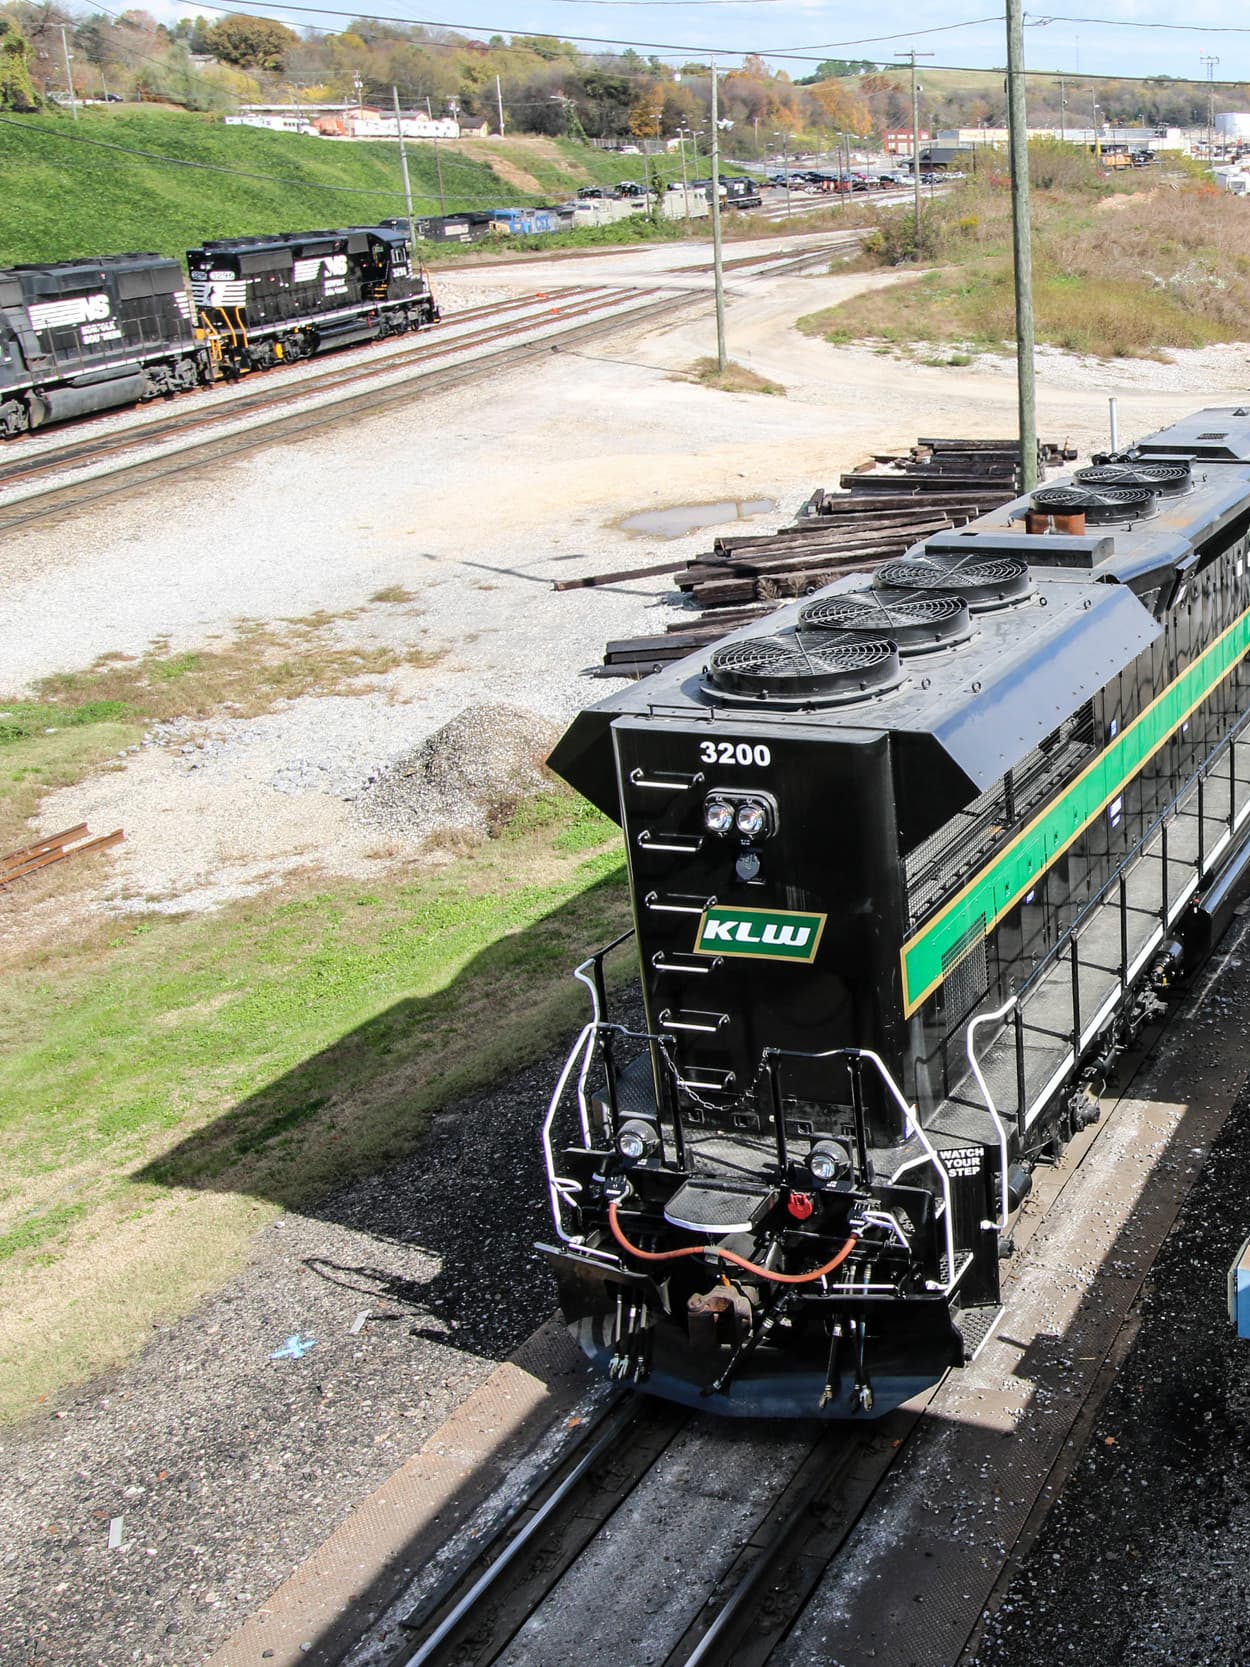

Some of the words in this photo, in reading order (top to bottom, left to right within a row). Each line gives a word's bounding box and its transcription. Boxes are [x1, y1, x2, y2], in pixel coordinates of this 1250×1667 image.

[322, 255, 348, 278] NS
[80, 294, 111, 322] NS
[700, 741, 771, 767] 3200
[703, 919, 811, 947] KLW
[940, 1147, 984, 1160] WATCH
[944, 1157, 981, 1169] YOUR
[948, 1166, 981, 1178] STEP
